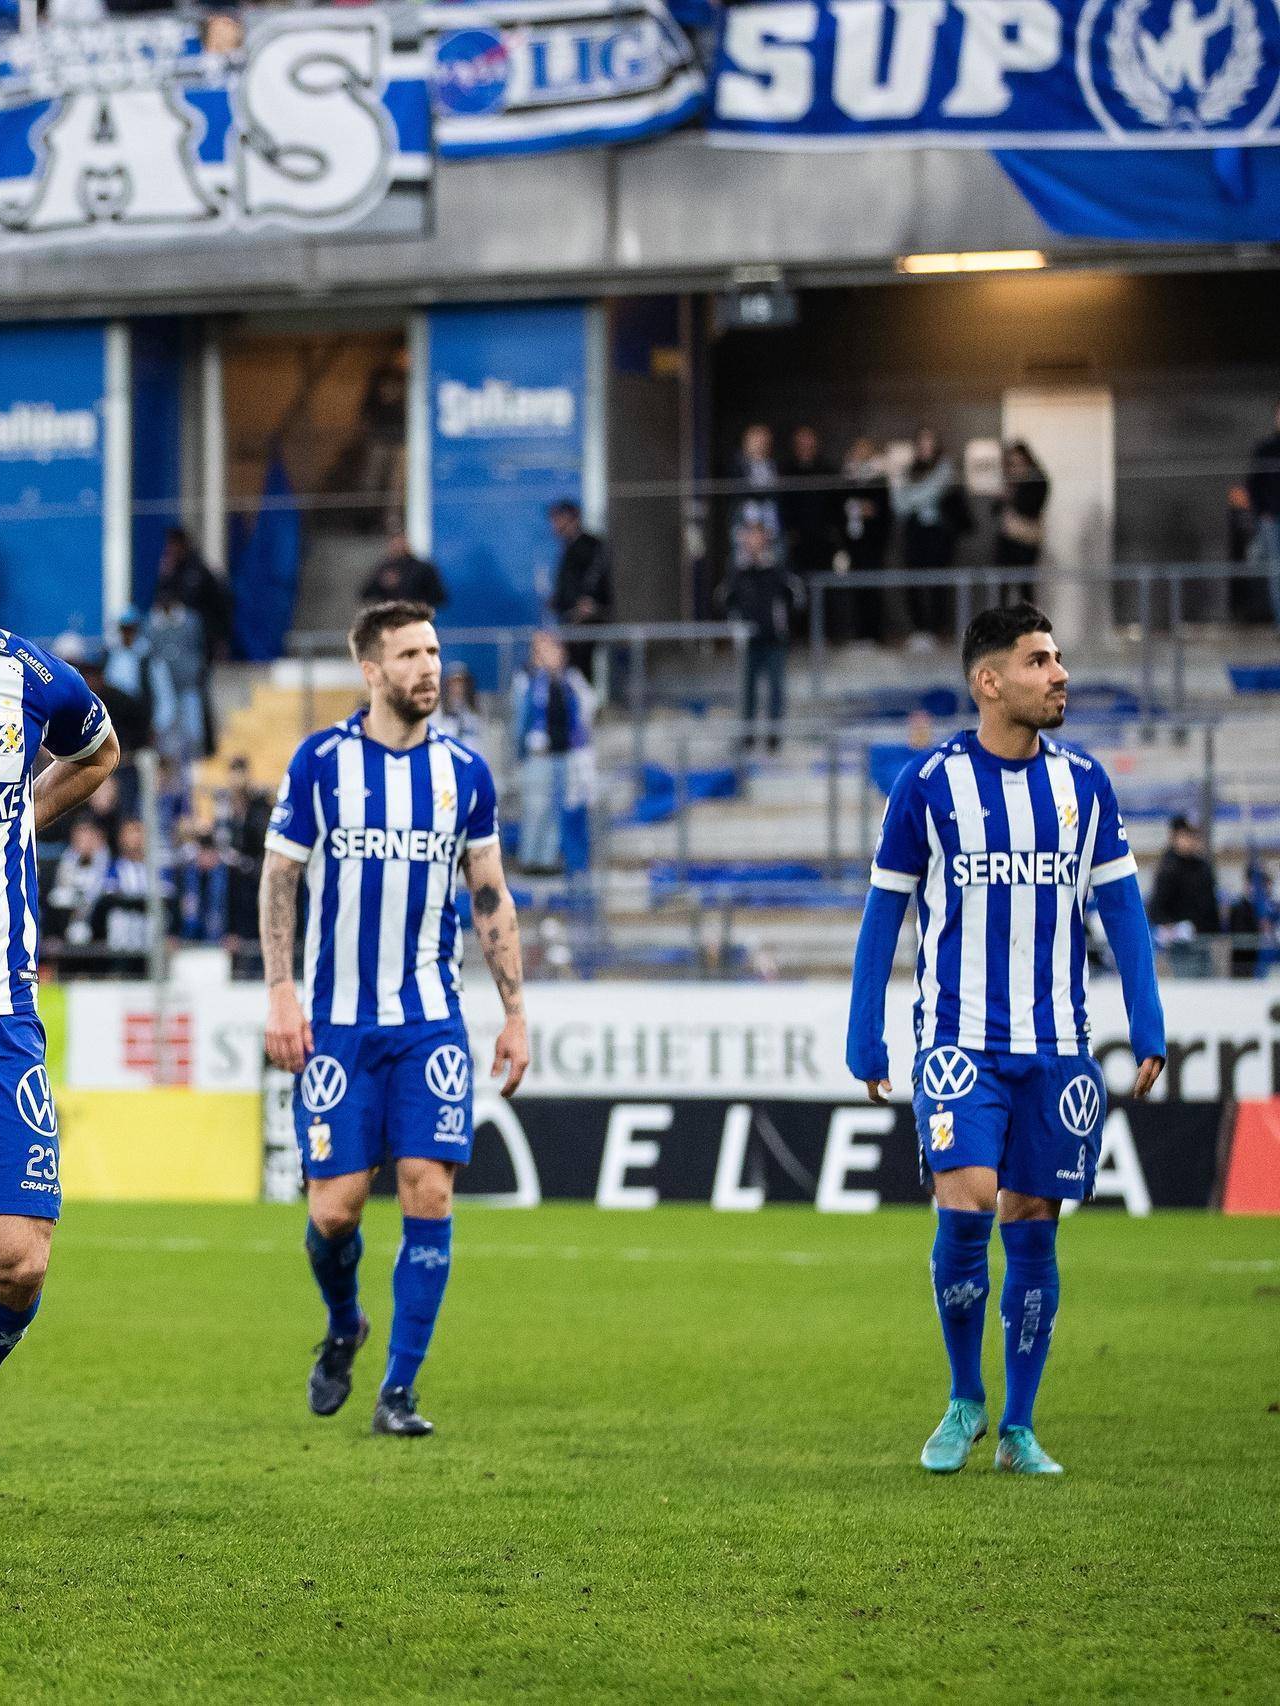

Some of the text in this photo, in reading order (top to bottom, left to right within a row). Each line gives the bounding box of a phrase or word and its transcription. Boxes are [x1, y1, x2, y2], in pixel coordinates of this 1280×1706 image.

[716, 0, 1062, 122] SUP
[16, 648, 53, 684] FAMECO
[436, 1104, 465, 1133] 30
[26, 1144, 58, 1180] 23
[20, 1180, 53, 1194] CRAFT
